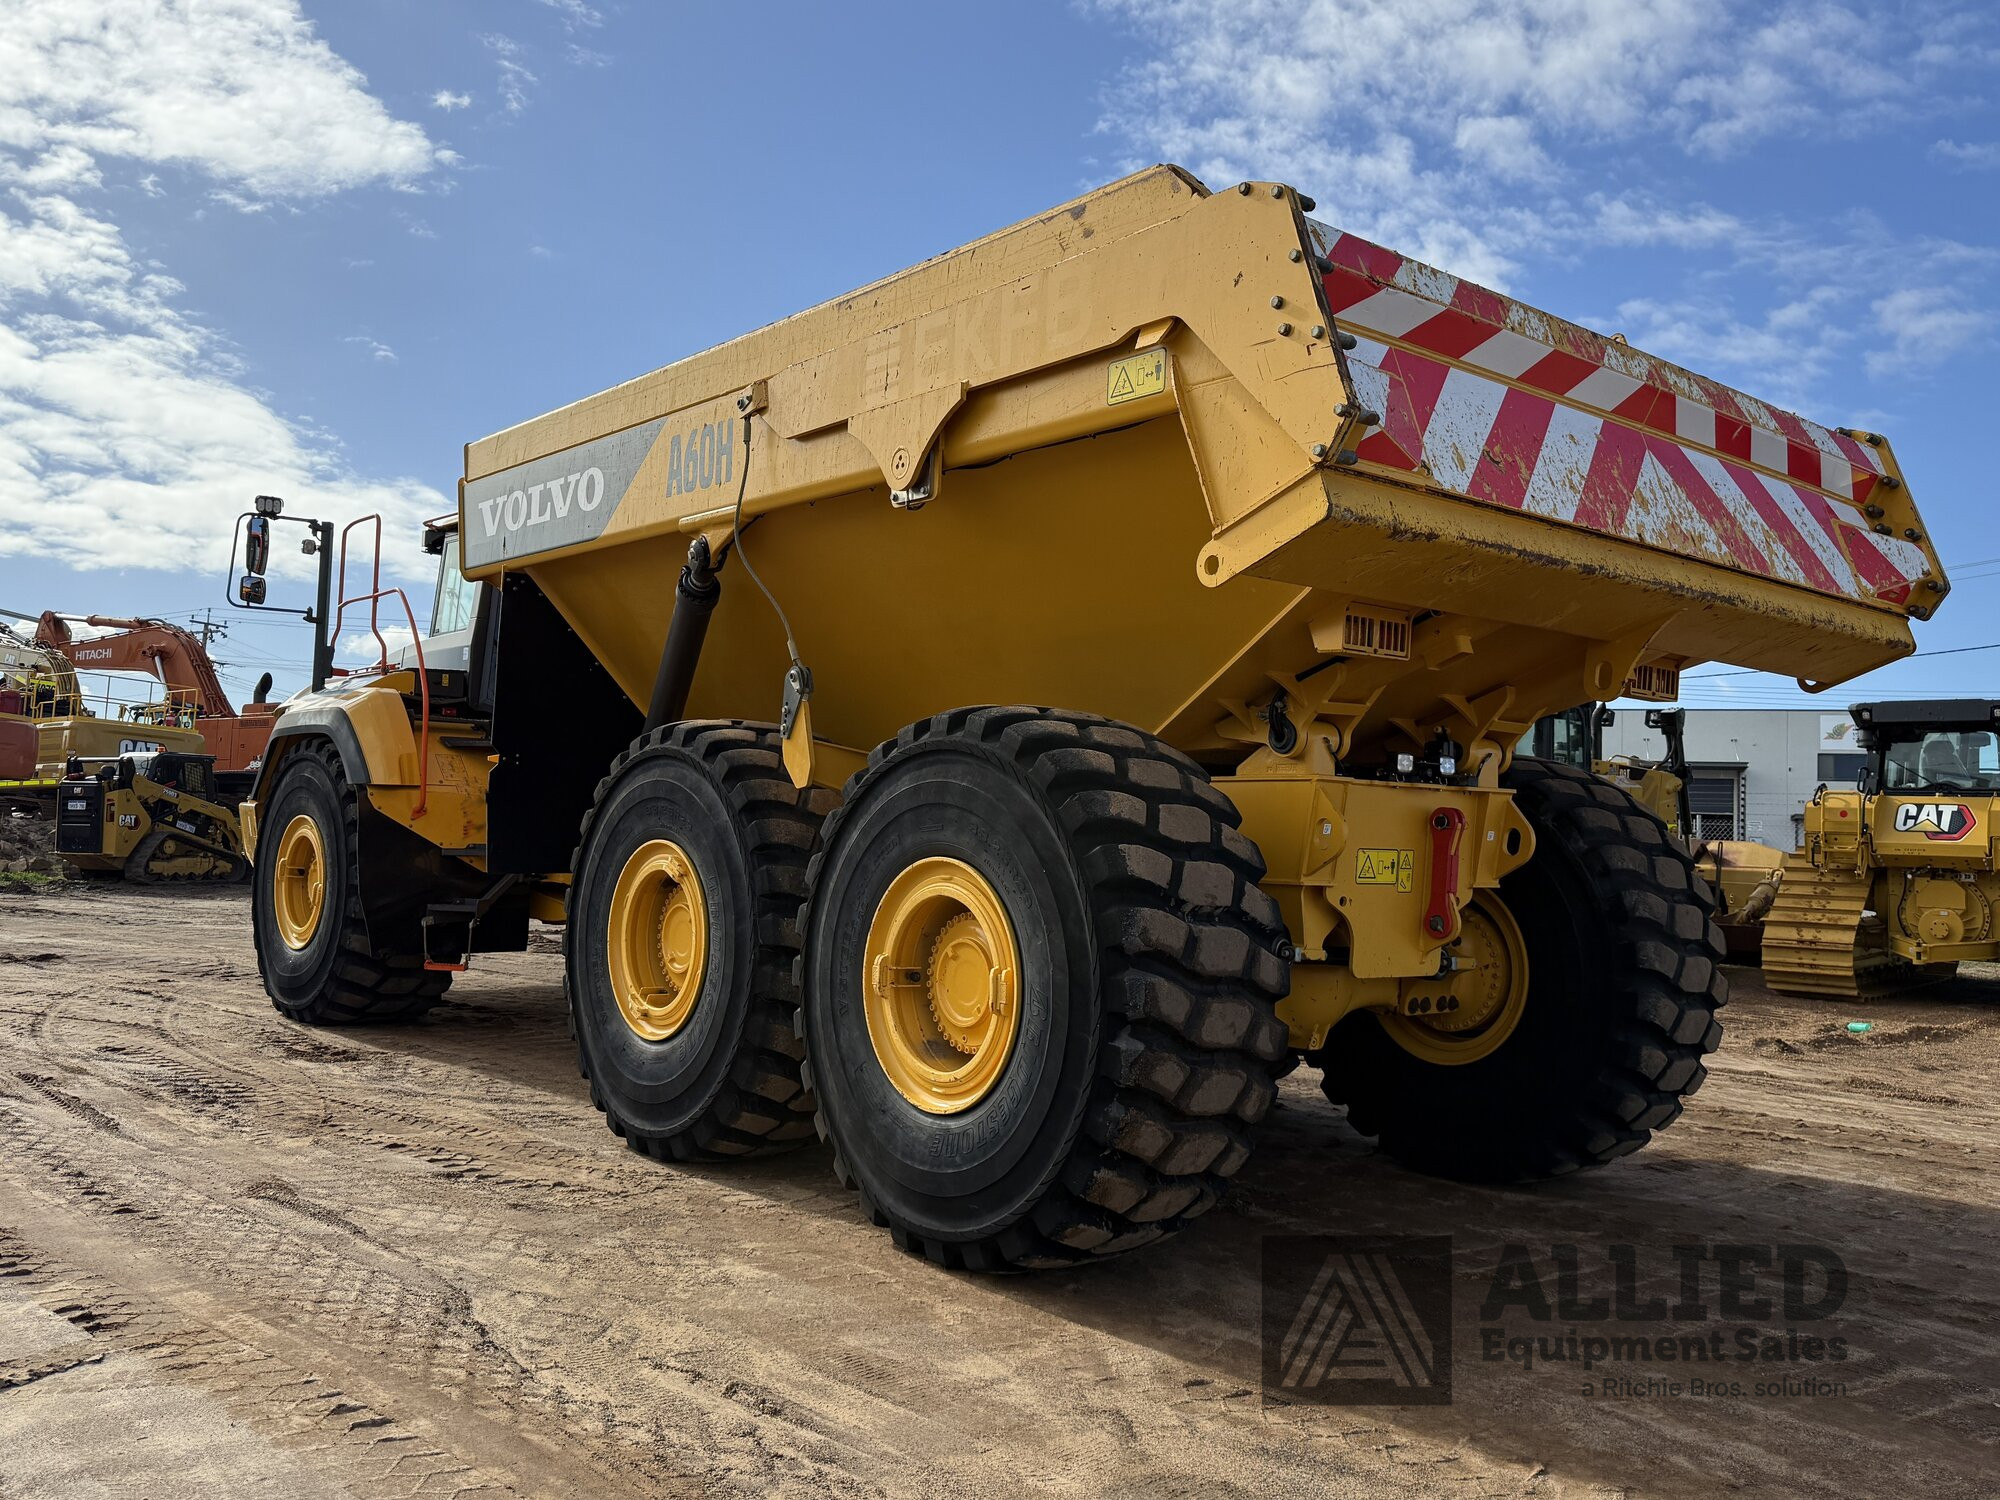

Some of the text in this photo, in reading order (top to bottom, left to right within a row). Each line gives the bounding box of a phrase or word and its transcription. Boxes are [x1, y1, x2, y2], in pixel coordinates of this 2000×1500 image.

[665, 417, 734, 498] A60H
[478, 467, 605, 537] VOLVO
[5, 653, 16, 665] CAT
[75, 648, 112, 661] HITACHI
[120, 739, 160, 753] CAT
[118, 814, 137, 827] CAT
[1896, 803, 1958, 833] CAT
[928, 983, 1049, 1158] BRDGESTONE
